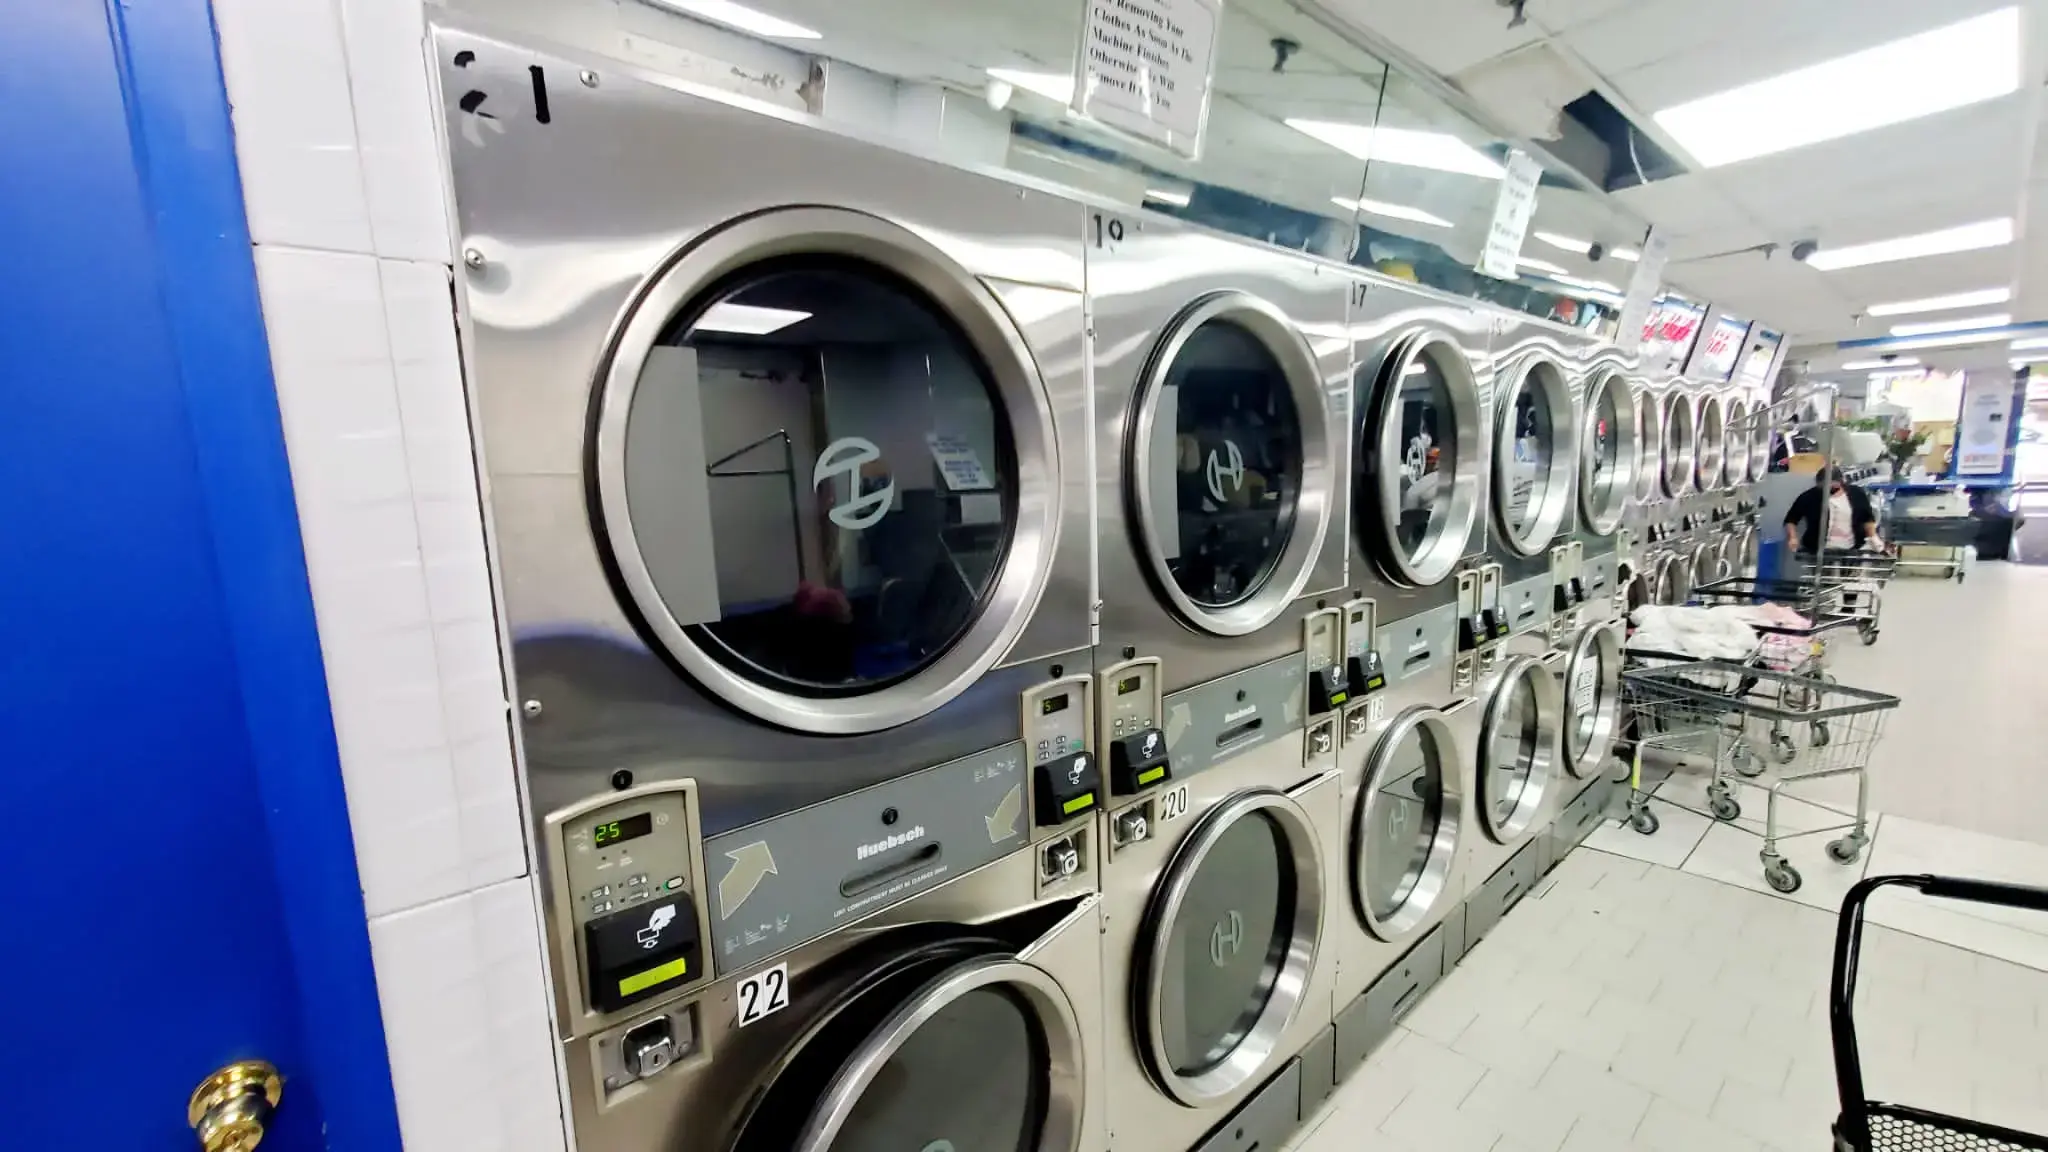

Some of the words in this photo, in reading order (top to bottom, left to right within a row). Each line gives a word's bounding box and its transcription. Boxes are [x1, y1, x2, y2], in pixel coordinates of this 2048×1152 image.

[1094, 7, 1131, 32] Clothes
[1135, 23, 1146, 39] As
[1092, 26, 1133, 54] Machine
[1351, 280, 1368, 309] 17
[1167, 786, 1186, 820] 20
[594, 821, 620, 843] 25
[856, 825, 926, 861] Huebsch
[740, 969, 785, 1023] 22
